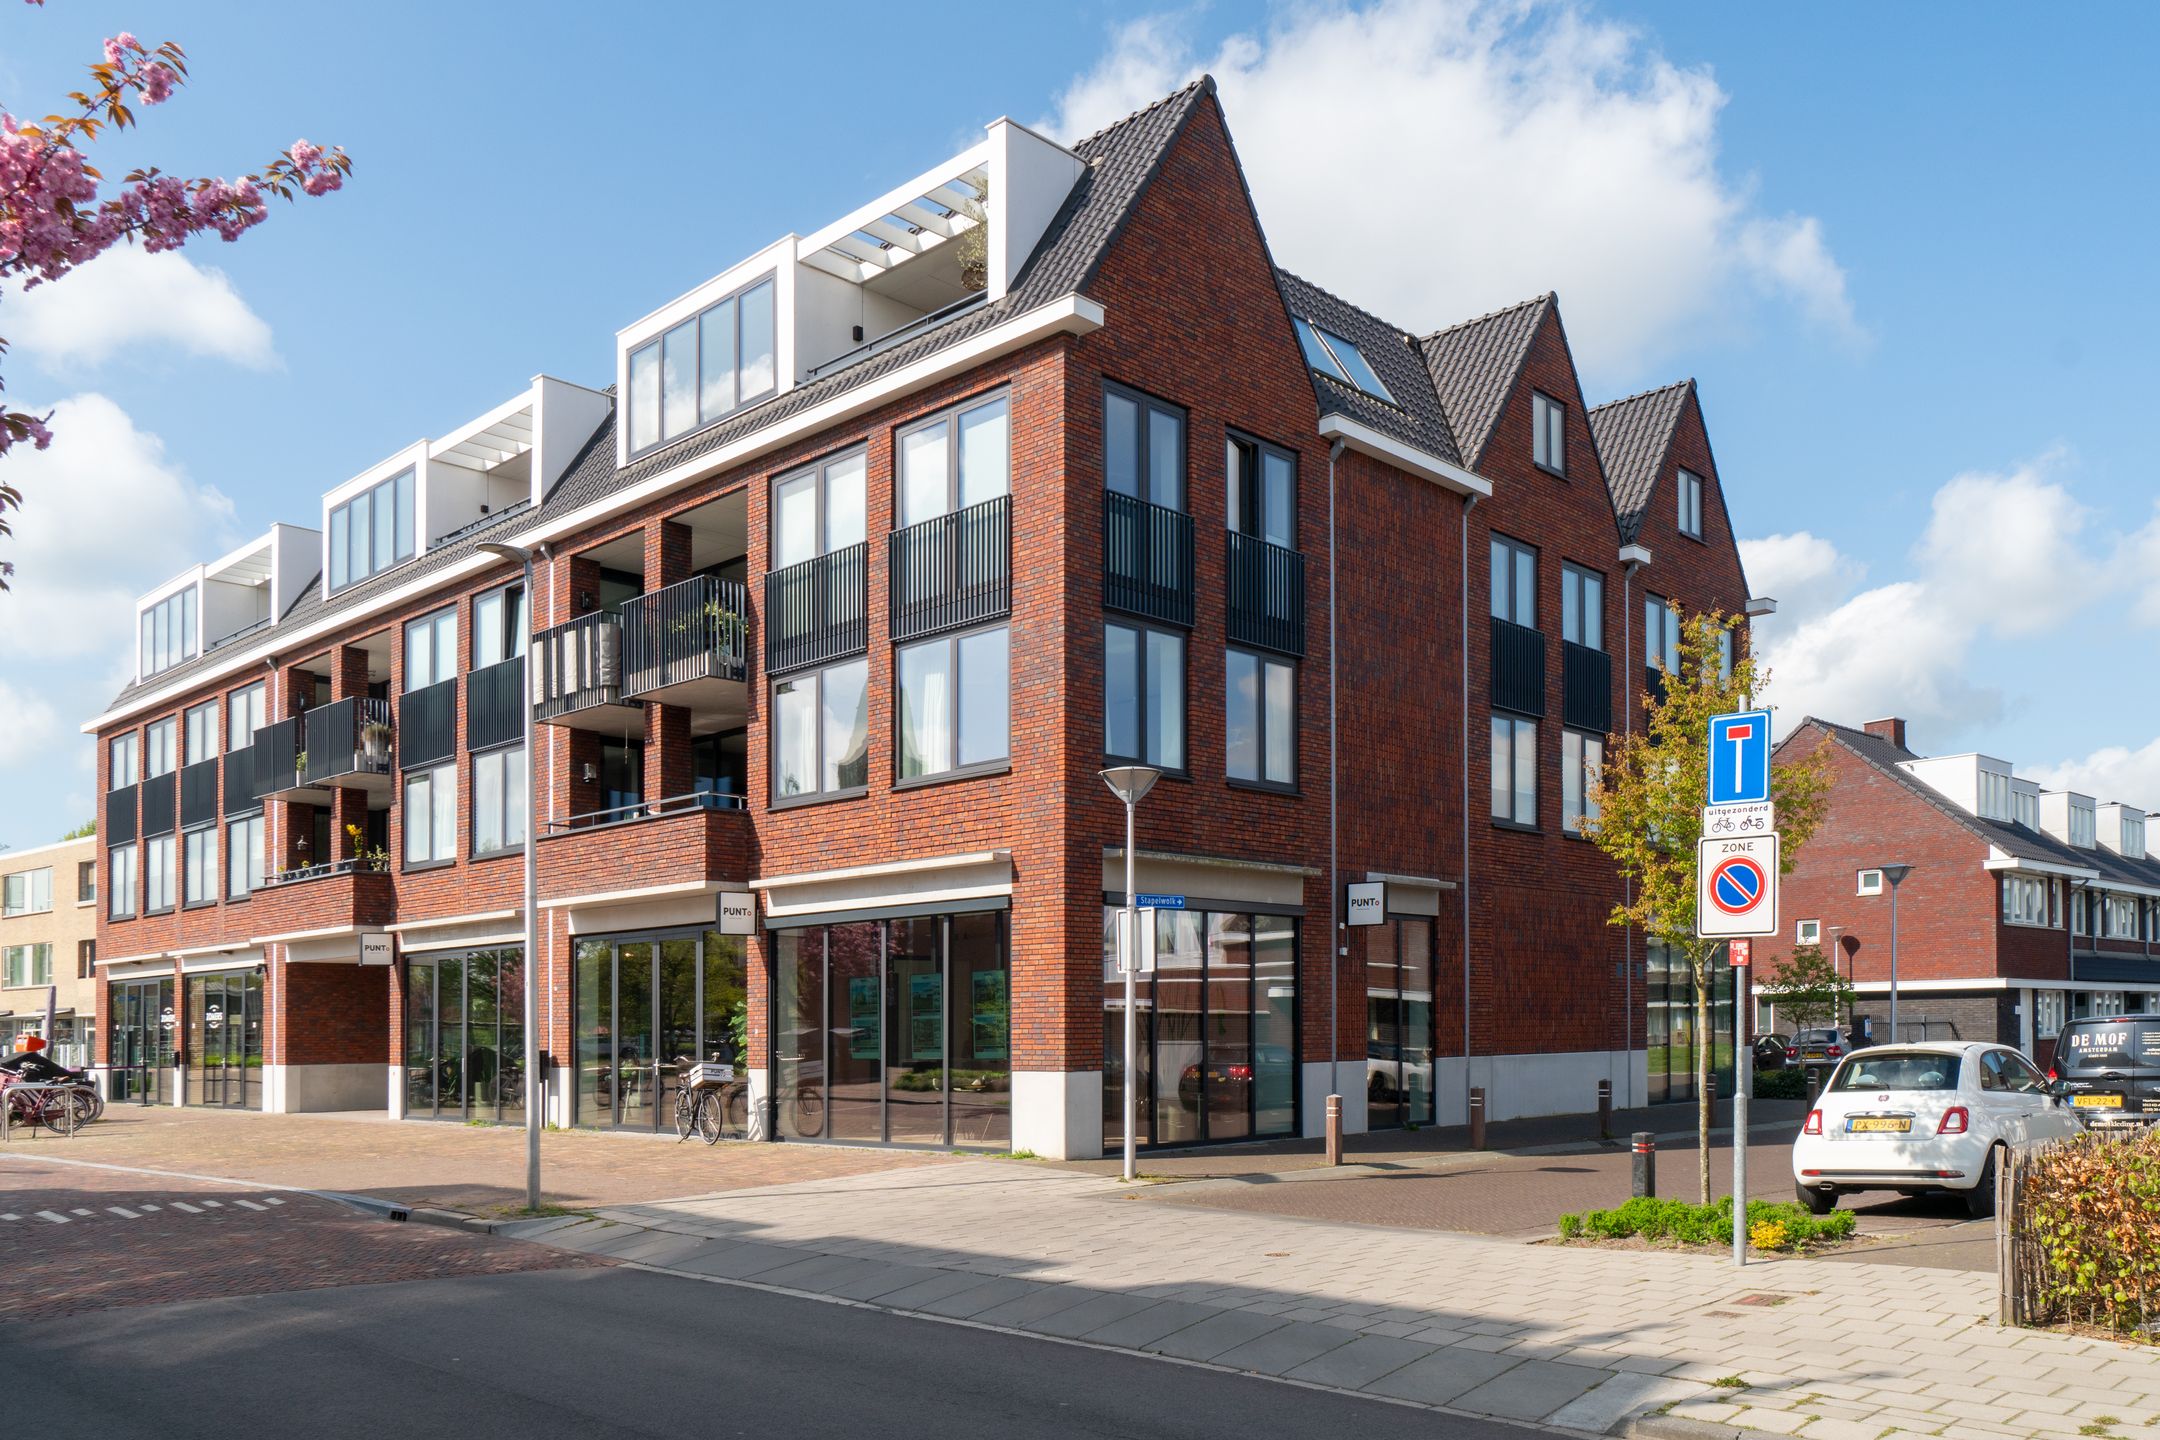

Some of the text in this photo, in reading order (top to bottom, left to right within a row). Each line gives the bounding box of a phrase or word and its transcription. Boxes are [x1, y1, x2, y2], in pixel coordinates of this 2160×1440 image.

[1709, 805, 1768, 816] uitgezonderd
[1722, 842, 1754, 852] ZONE
[2071, 1034, 2090, 1047] DE
[2094, 1032, 2128, 1046] MOF
[2077, 1097, 2117, 1106] VFL-22-K
